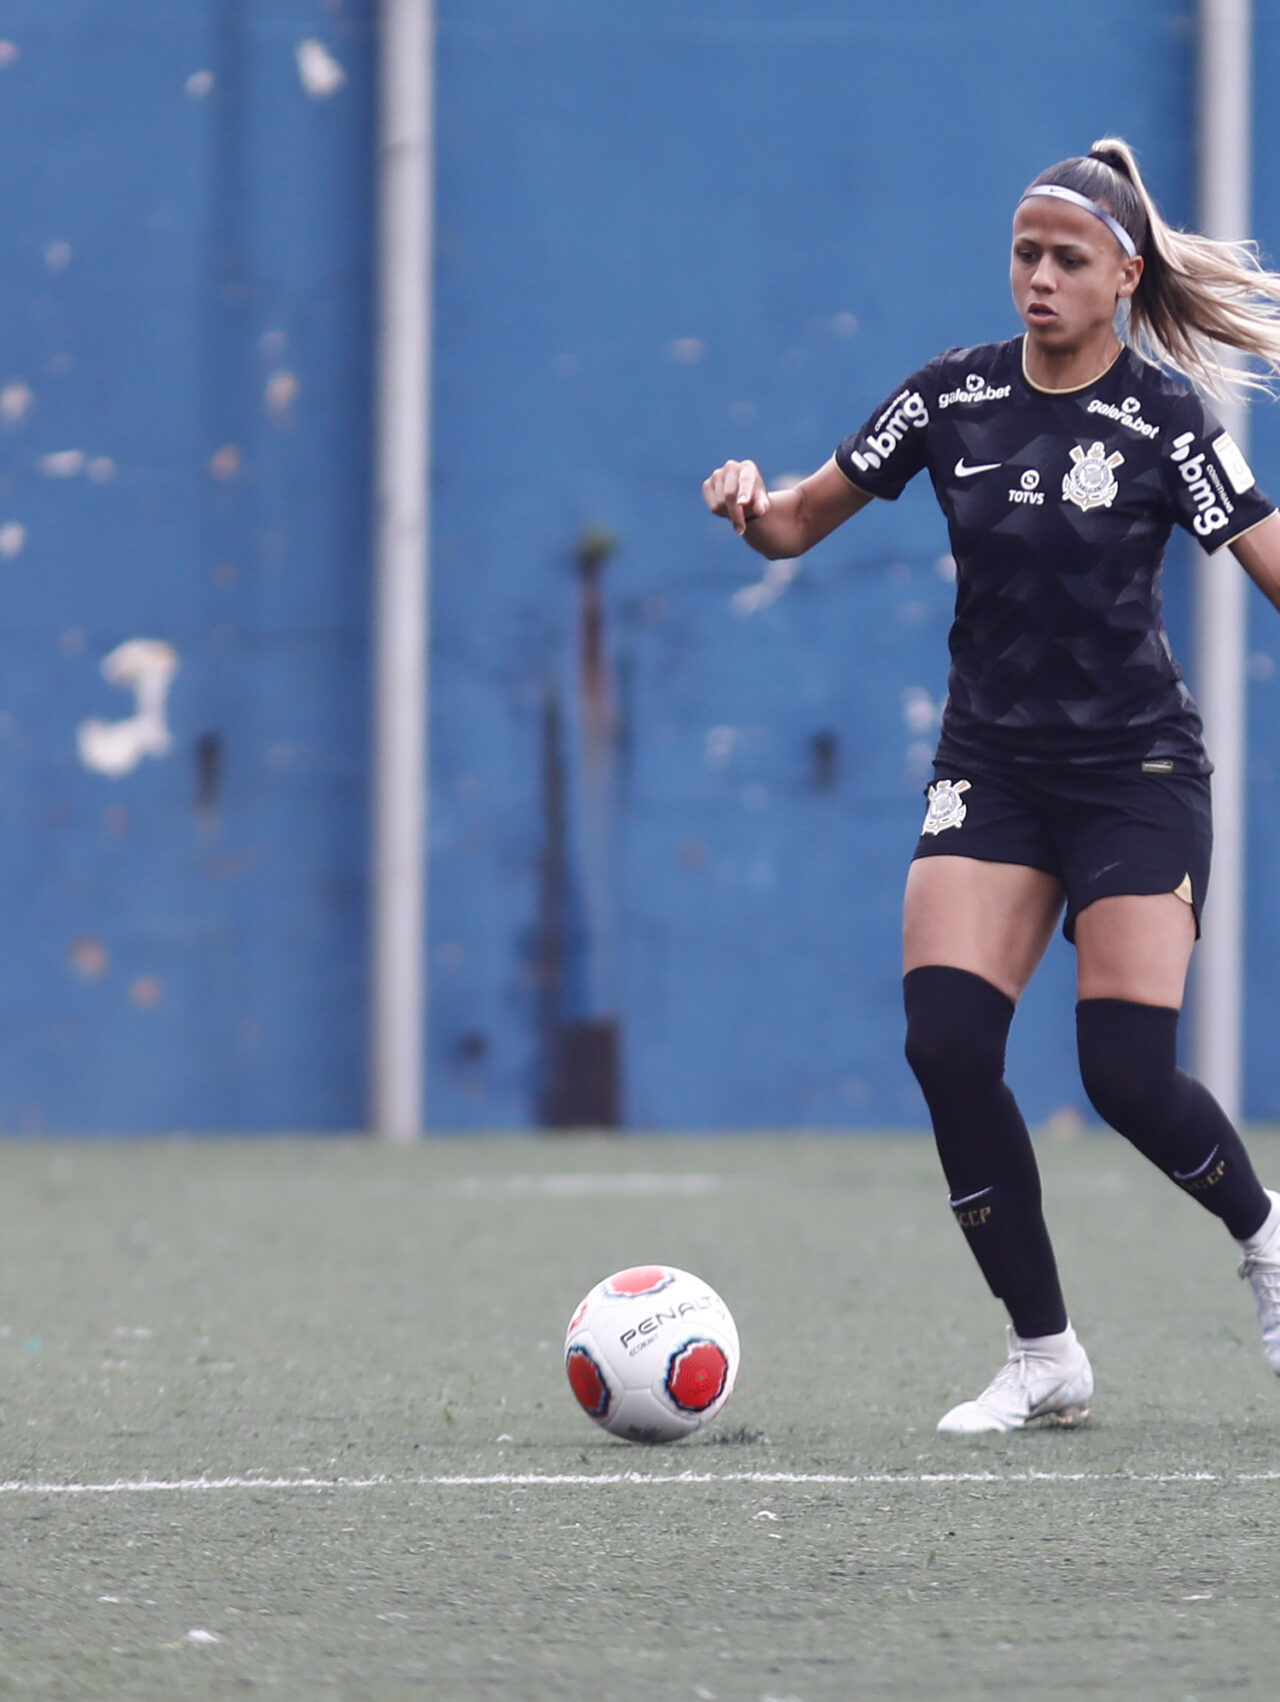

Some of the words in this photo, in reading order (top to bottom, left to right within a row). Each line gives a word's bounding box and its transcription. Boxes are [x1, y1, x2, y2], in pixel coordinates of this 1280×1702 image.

[939, 384, 1011, 408] galera.bet
[866, 392, 929, 459] bmg
[1087, 399, 1160, 439] galera.bet
[1008, 489, 1045, 505] TOTVS
[1178, 453, 1229, 536] bmg
